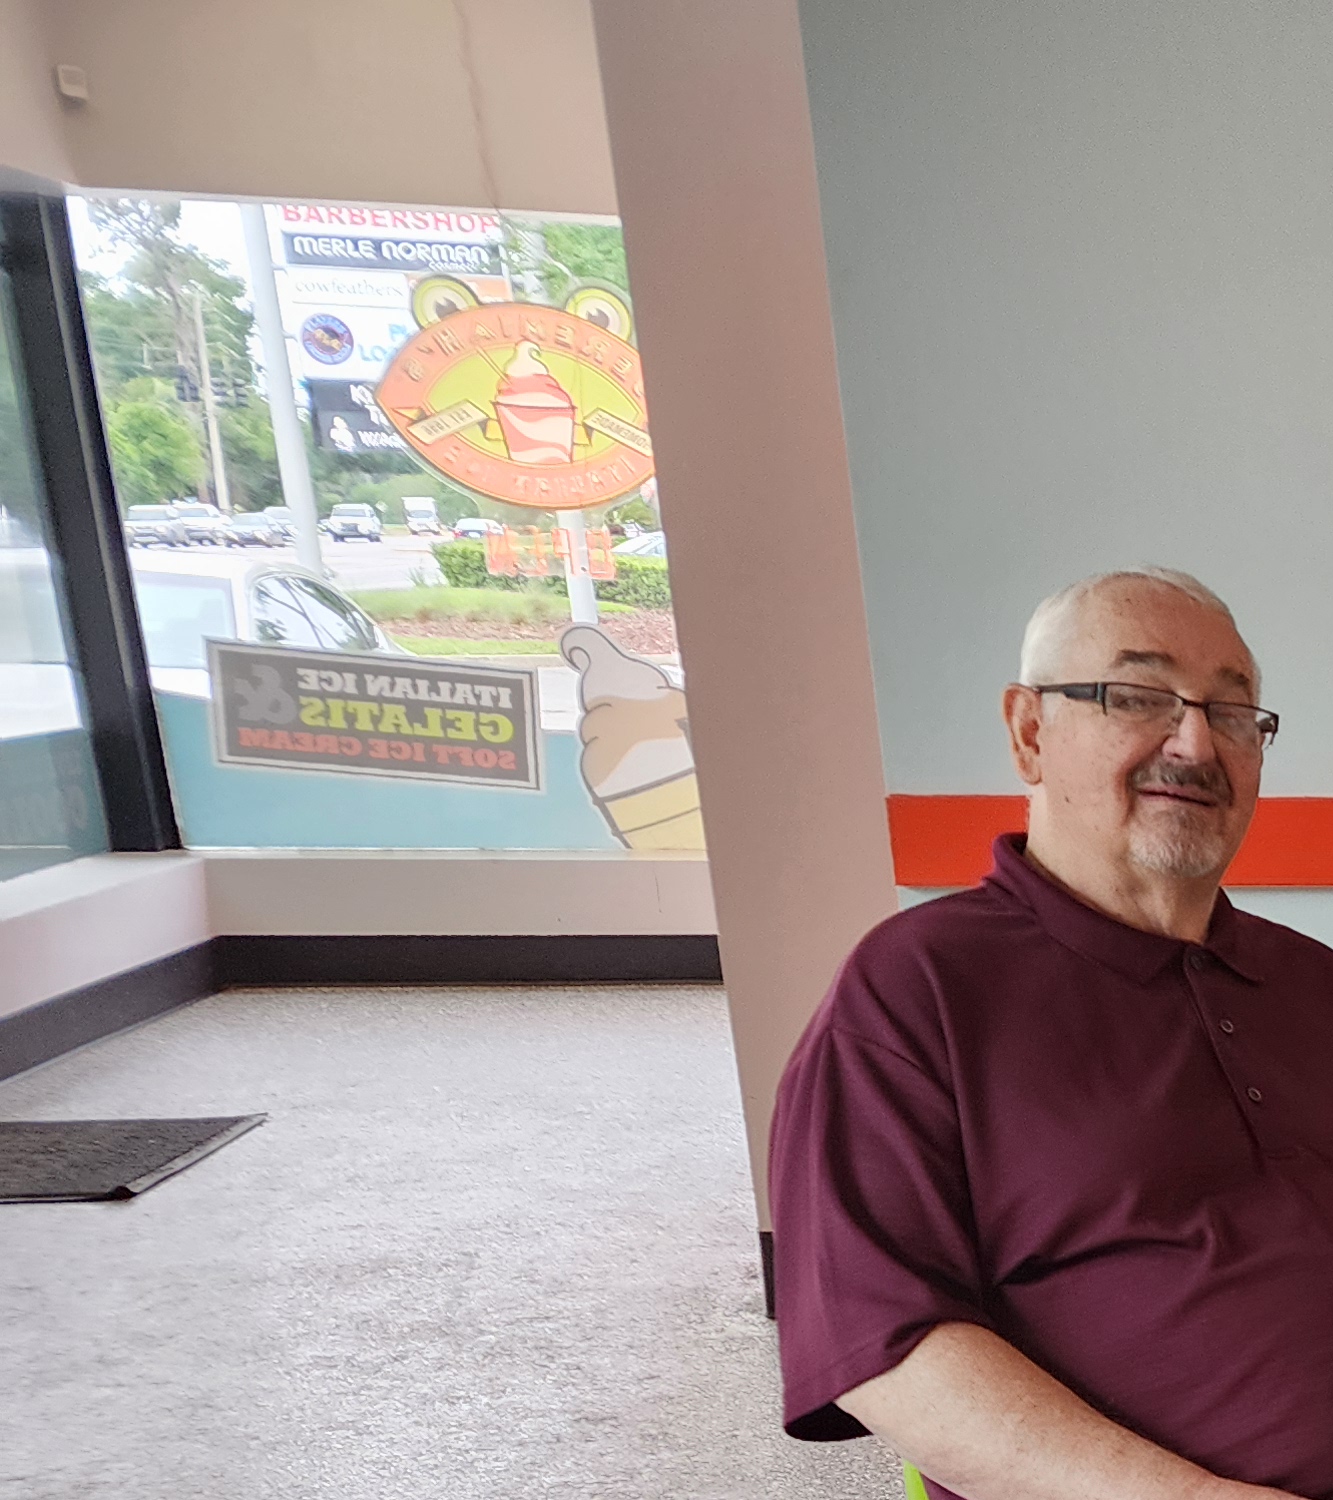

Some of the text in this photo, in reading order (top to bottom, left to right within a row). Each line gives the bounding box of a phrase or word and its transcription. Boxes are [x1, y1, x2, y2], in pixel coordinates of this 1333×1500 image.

[283, 203, 500, 235] BARBERSHOP
[293, 235, 490, 265] MERLE NORMAN
[295, 278, 404, 298] cowfeathers
